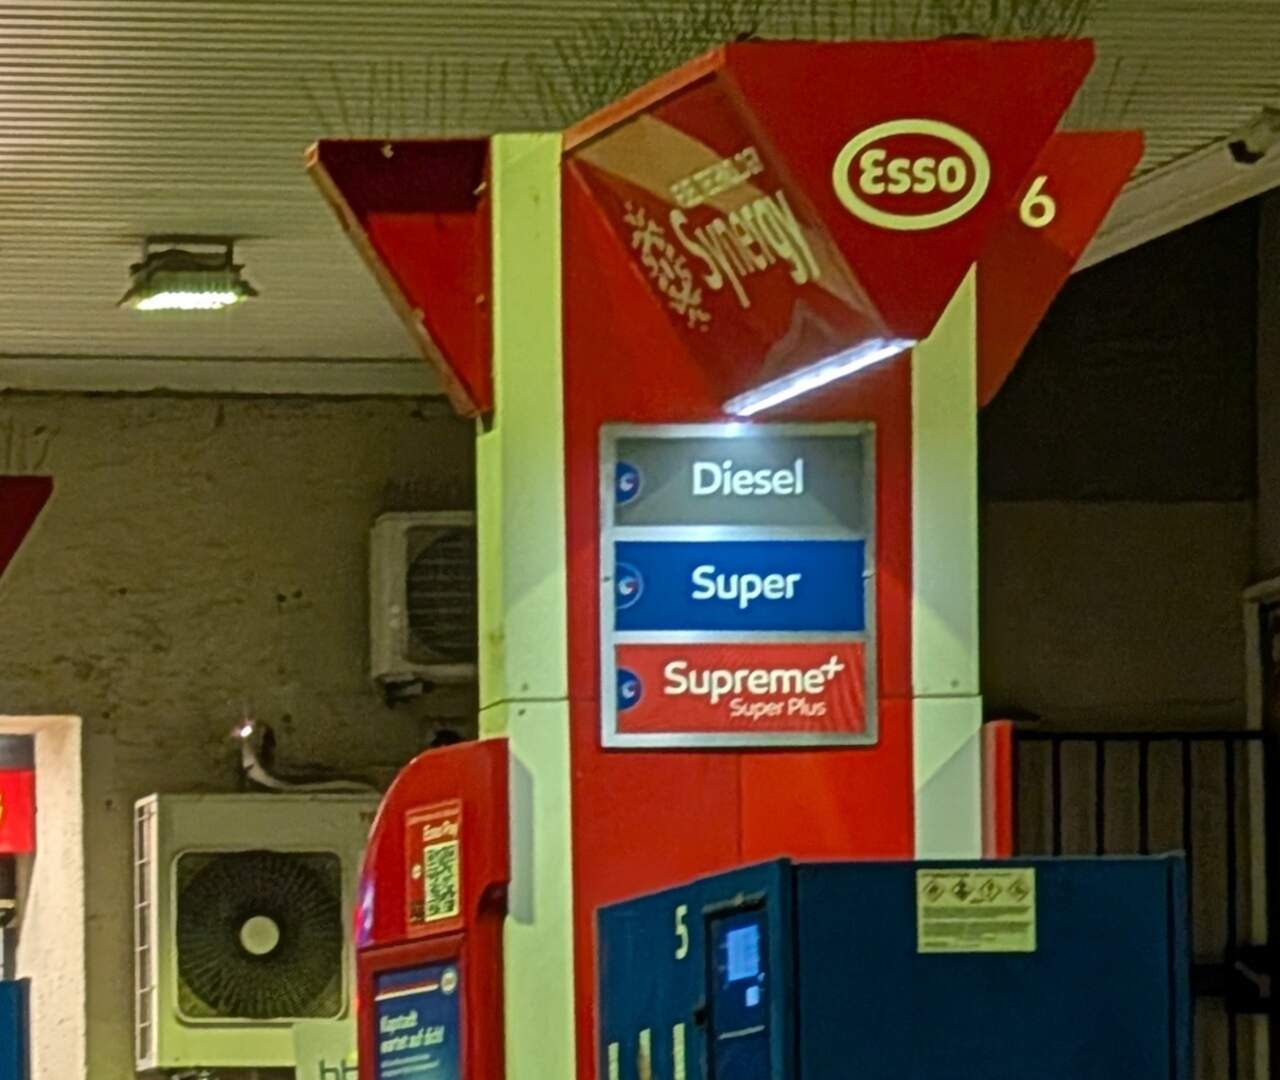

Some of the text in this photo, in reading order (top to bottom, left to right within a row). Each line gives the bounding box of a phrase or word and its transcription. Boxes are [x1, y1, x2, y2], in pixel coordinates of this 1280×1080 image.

[859, 149, 967, 195] Esso
[1019, 175, 1056, 228] 6
[669, 190, 821, 308] Synergy
[692, 457, 804, 496] Diesel
[691, 564, 801, 609] Super
[663, 655, 845, 704] Supreme+
[729, 697, 827, 721] Super Plus
[674, 904, 690, 960] 5
